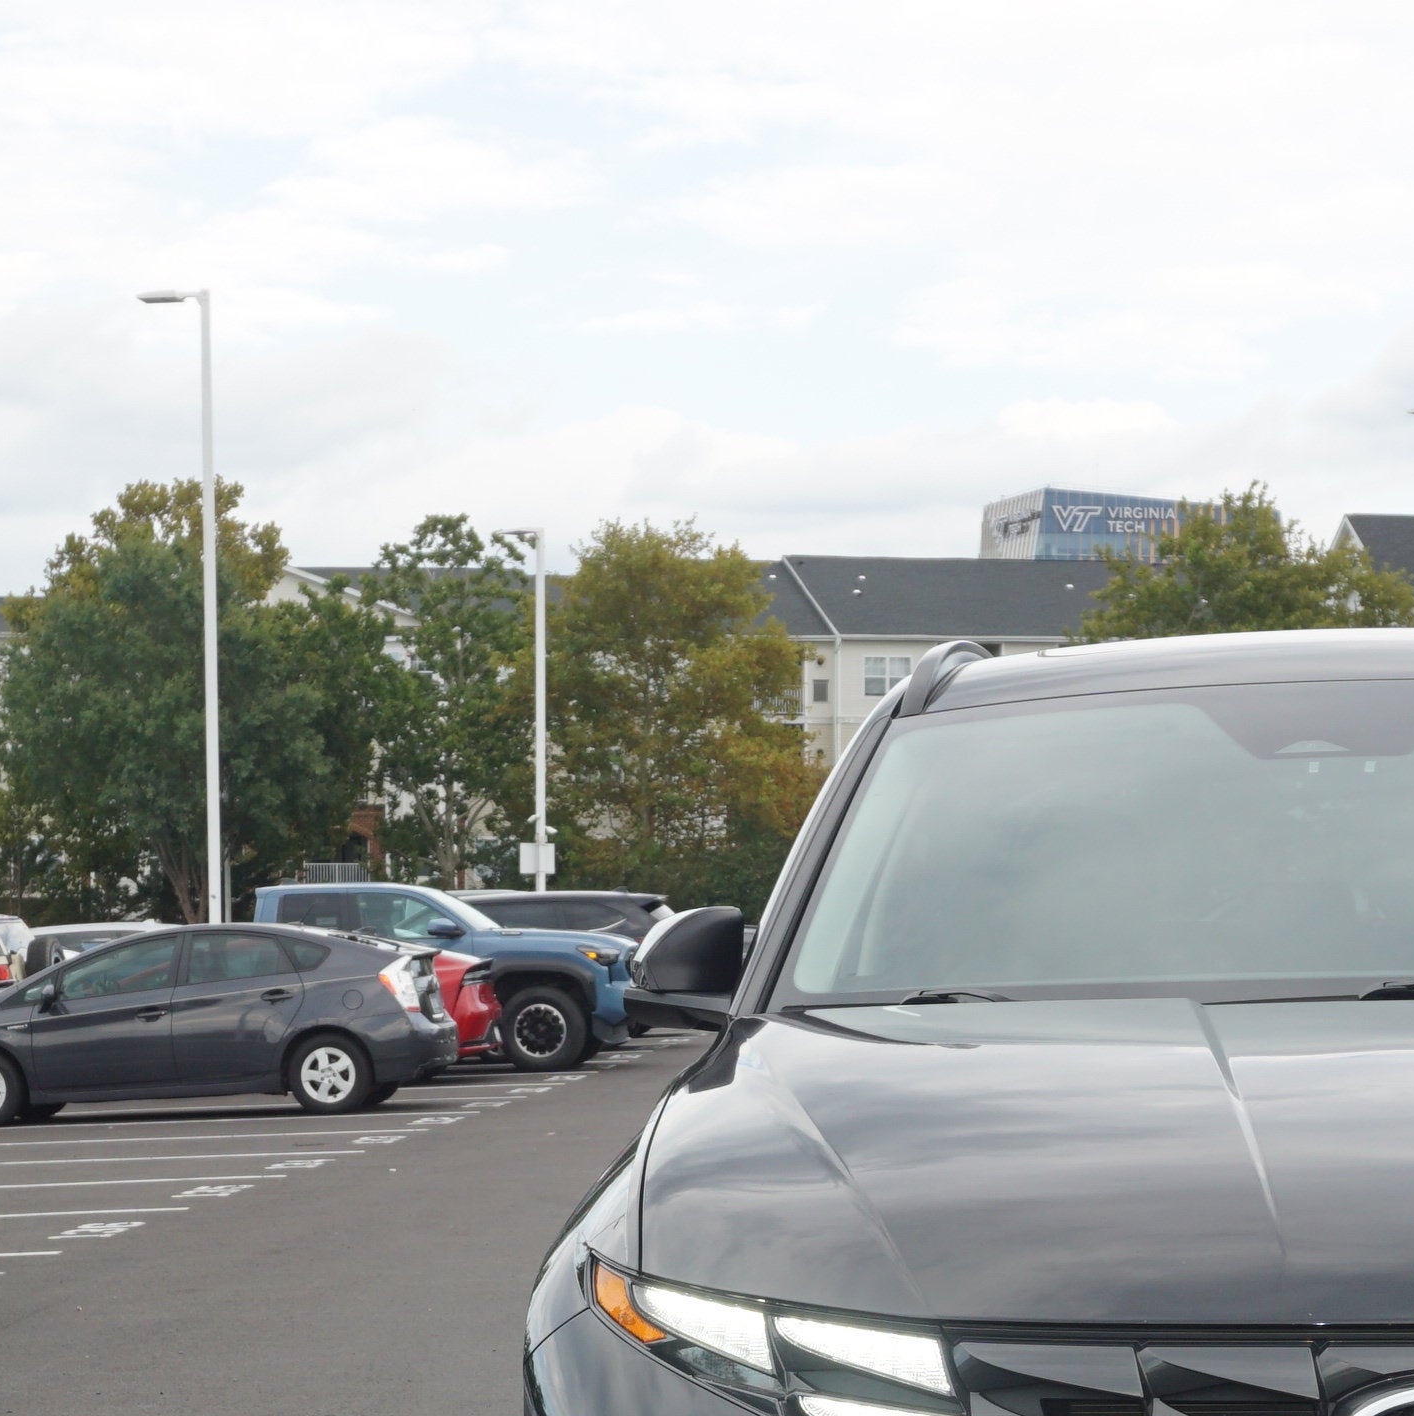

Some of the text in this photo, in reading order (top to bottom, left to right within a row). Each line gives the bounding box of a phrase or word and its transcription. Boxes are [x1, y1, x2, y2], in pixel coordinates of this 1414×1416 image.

[1051, 505, 1103, 533] VT
[1107, 506, 1176, 520] VIRGINIA
[1107, 520, 1145, 533] TECH
[47, 1221, 146, 1240] 136
